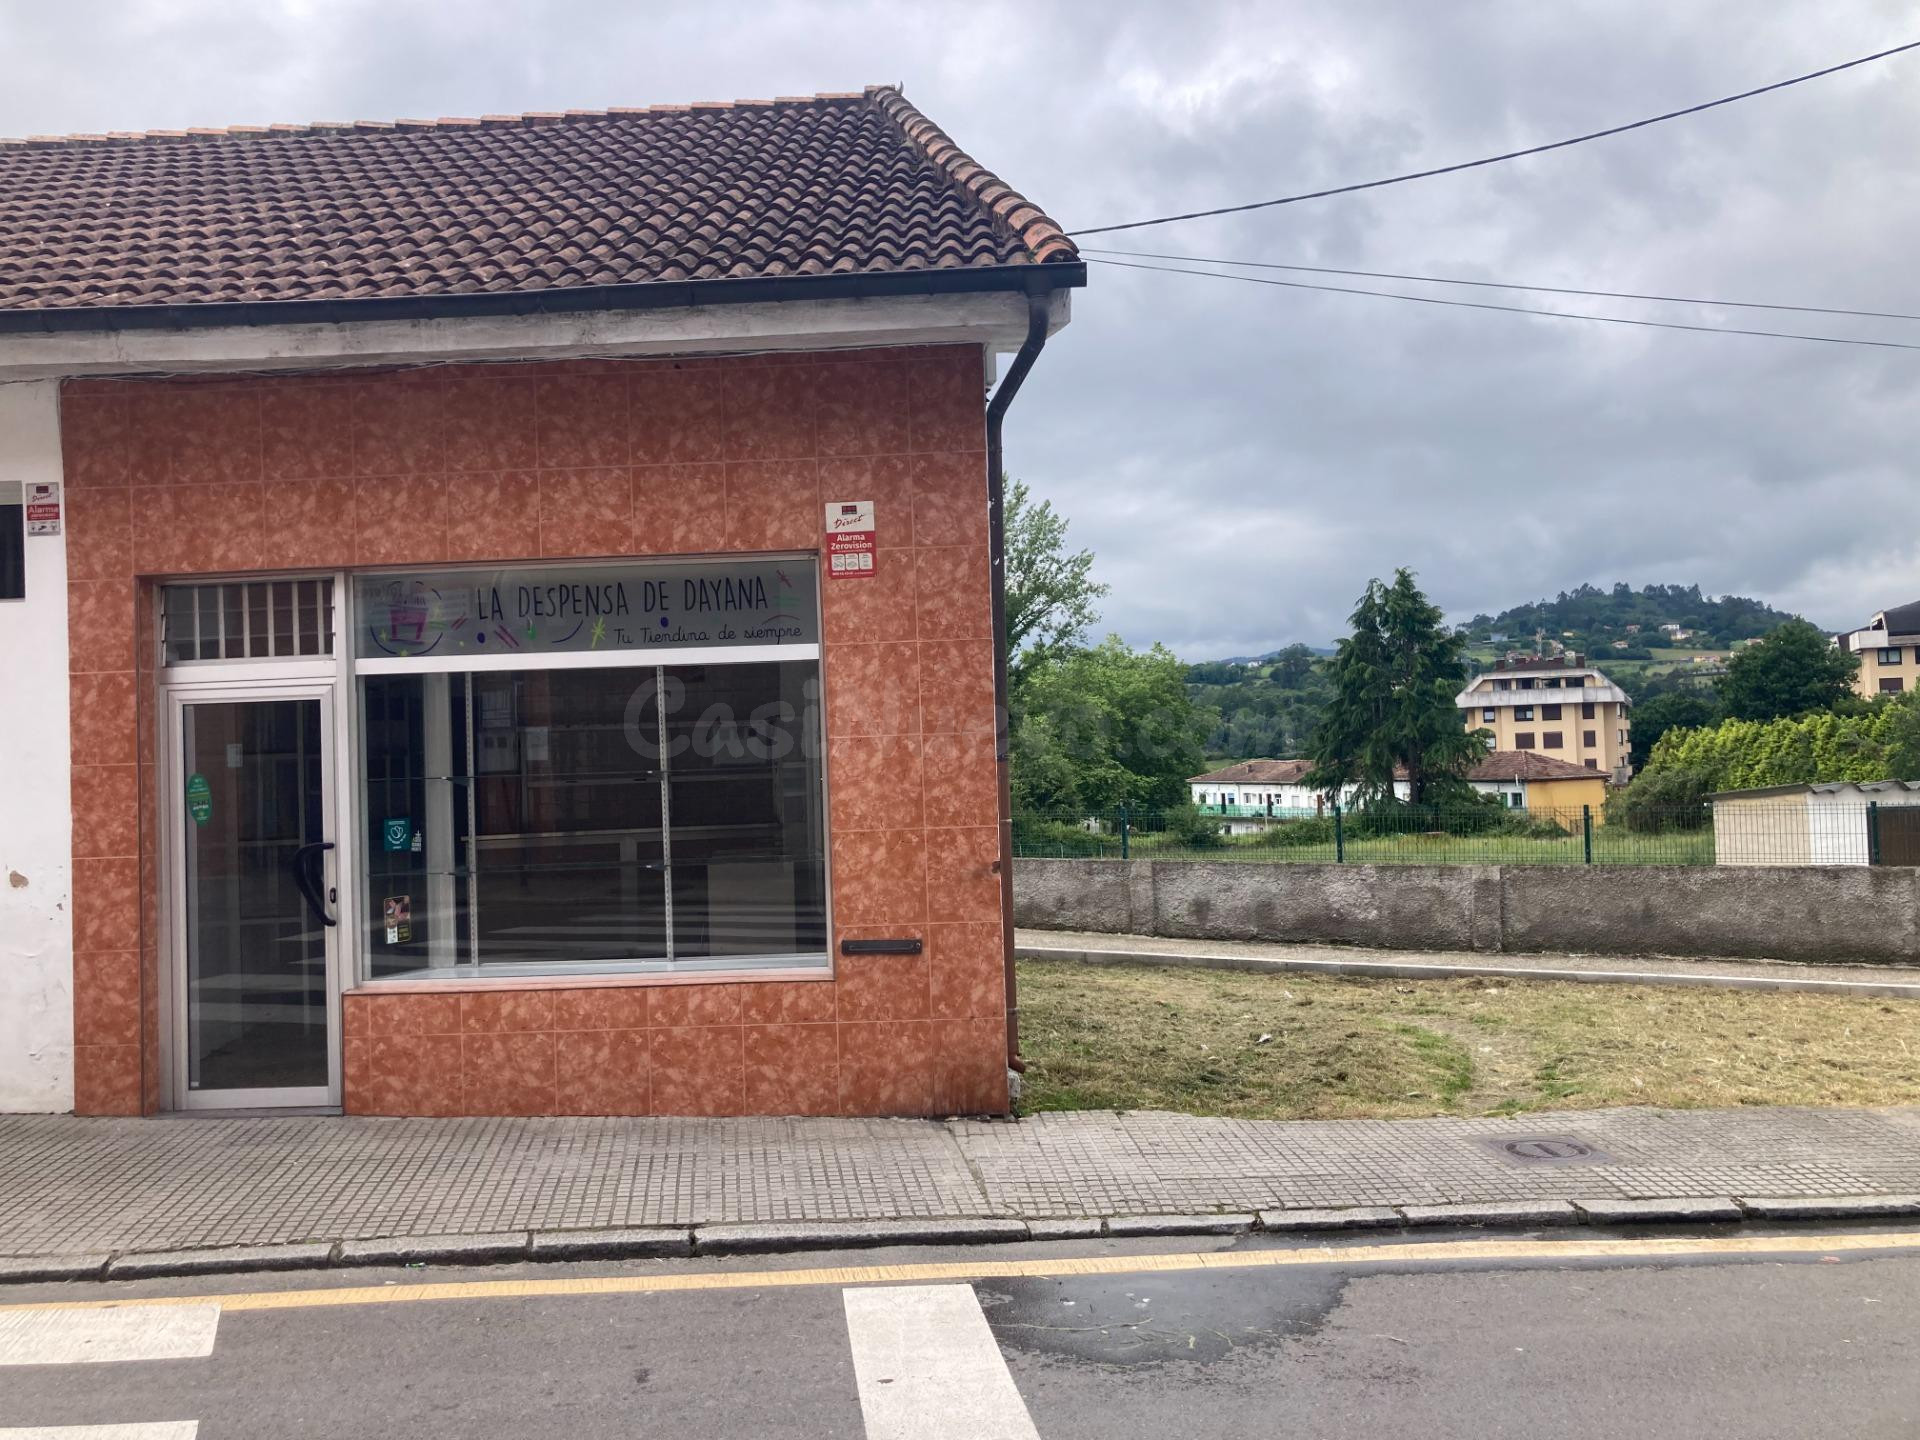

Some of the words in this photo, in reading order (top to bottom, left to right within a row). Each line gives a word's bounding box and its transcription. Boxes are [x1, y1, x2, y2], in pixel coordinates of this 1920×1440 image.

[831, 541, 872, 550] Zerovision
[837, 534, 865, 542] Alarma
[477, 587, 504, 620] LA
[518, 580, 629, 618] DESPENSA
[643, 580, 670, 613] DE
[684, 575, 769, 612] DAYANA
[613, 628, 633, 645] Tu
[640, 626, 710, 644] Tiendina
[718, 624, 736, 641] de
[743, 623, 802, 645] siempre
